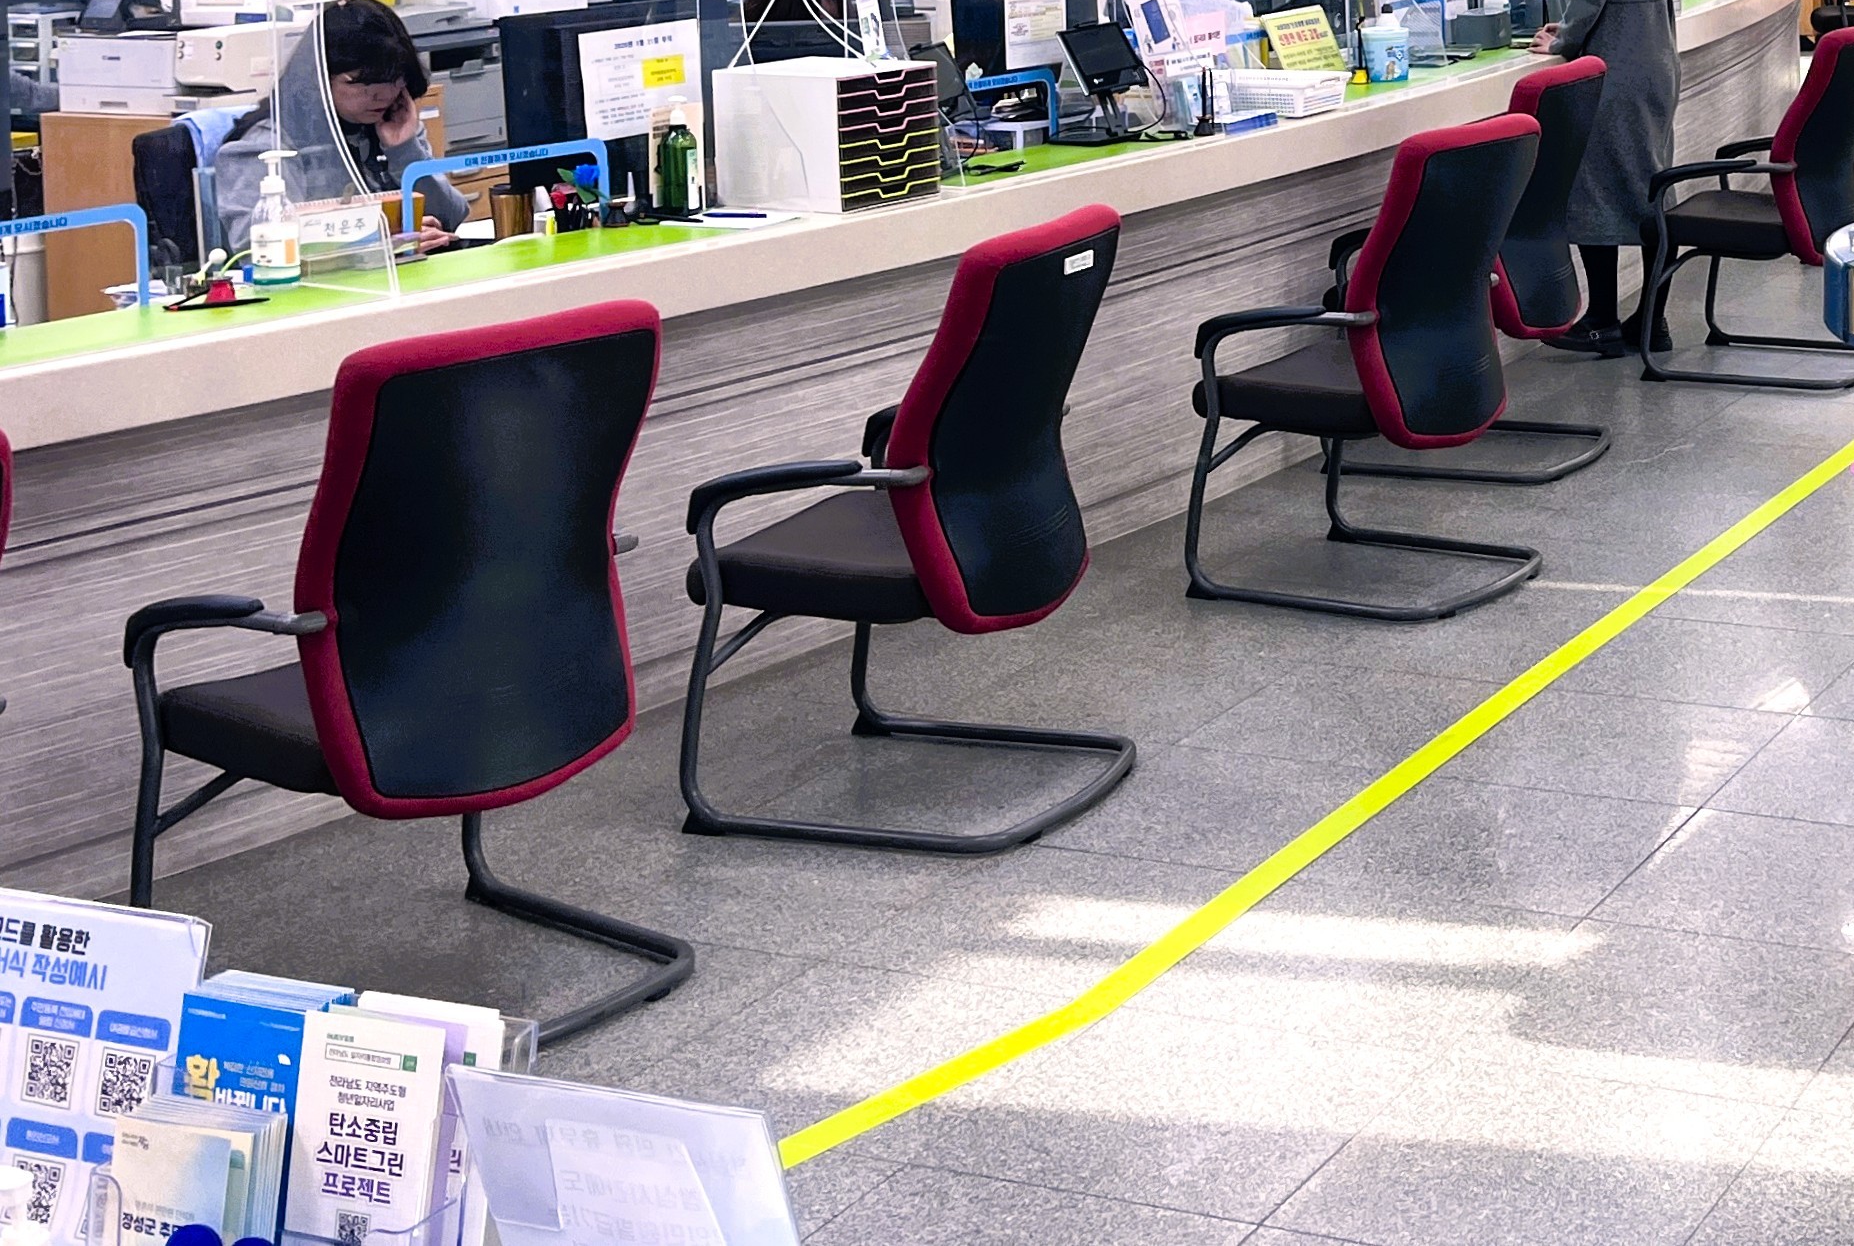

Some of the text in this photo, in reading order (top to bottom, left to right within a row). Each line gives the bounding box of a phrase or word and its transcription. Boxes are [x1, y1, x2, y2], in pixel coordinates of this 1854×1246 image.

[40, 924, 90, 955] 활용한
[31, 953, 107, 991] 작성예시
[329, 1074, 407, 1098] 전라남도 지역주도형
[329, 1112, 398, 1146] 탄소중립
[316, 1141, 404, 1177] 스마트그린
[321, 1171, 391, 1204] 프로젝트
[122, 1212, 156, 1237] 장성군
